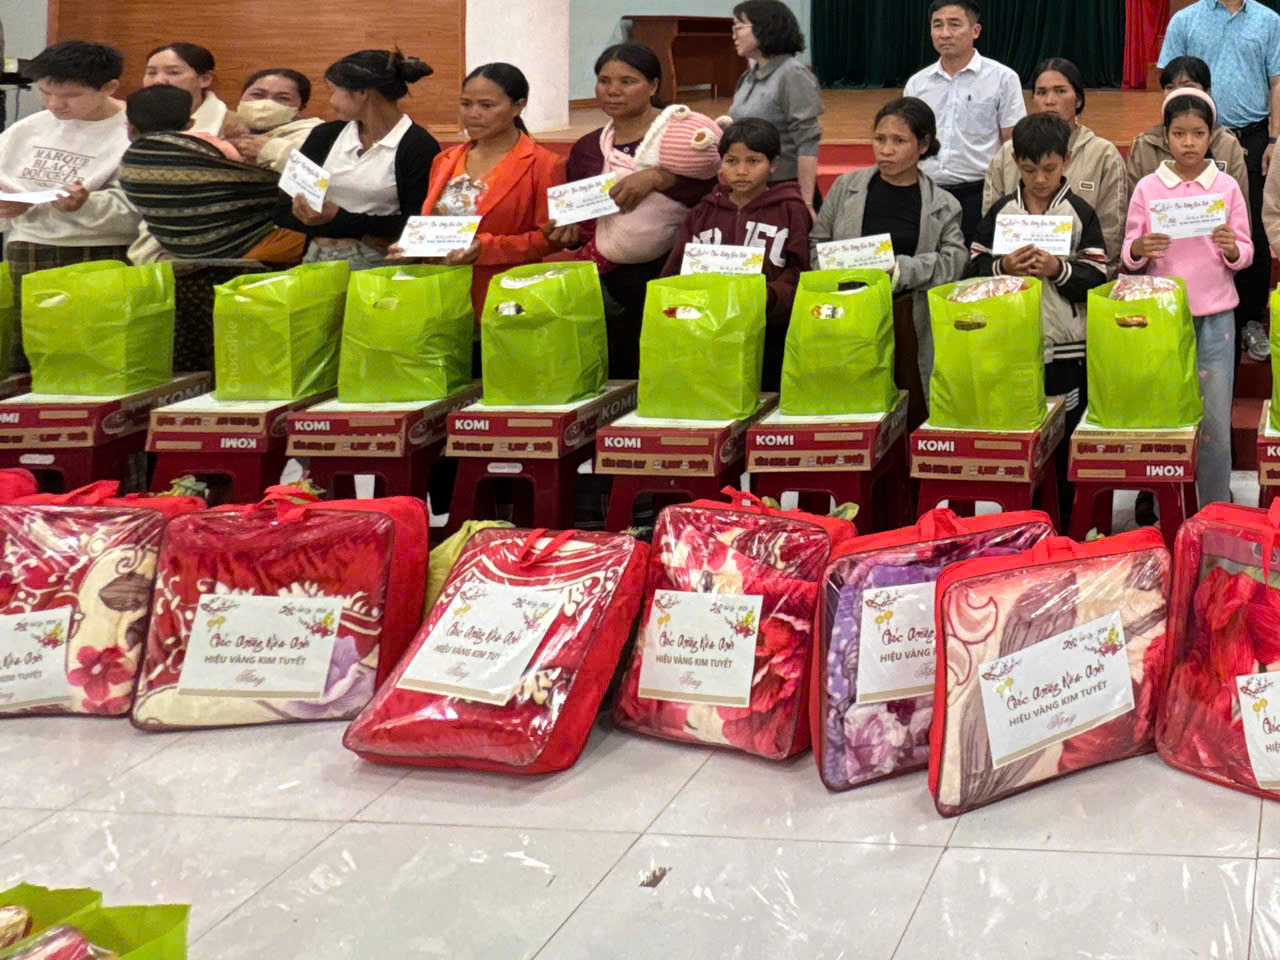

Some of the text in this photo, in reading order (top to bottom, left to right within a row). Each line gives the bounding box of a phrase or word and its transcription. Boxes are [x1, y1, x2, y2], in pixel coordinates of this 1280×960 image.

[295, 420, 331, 432] KOMI
[455, 419, 490, 431] KOMI
[221, 438, 257, 449] KOMI
[604, 437, 642, 449] KOMI
[756, 434, 794, 446] KOMI
[917, 439, 955, 452] KOMI
[1146, 464, 1184, 477] KOMI
[1008, 678, 1108, 728] HIỆU VÀNG KIM TUYẾT
